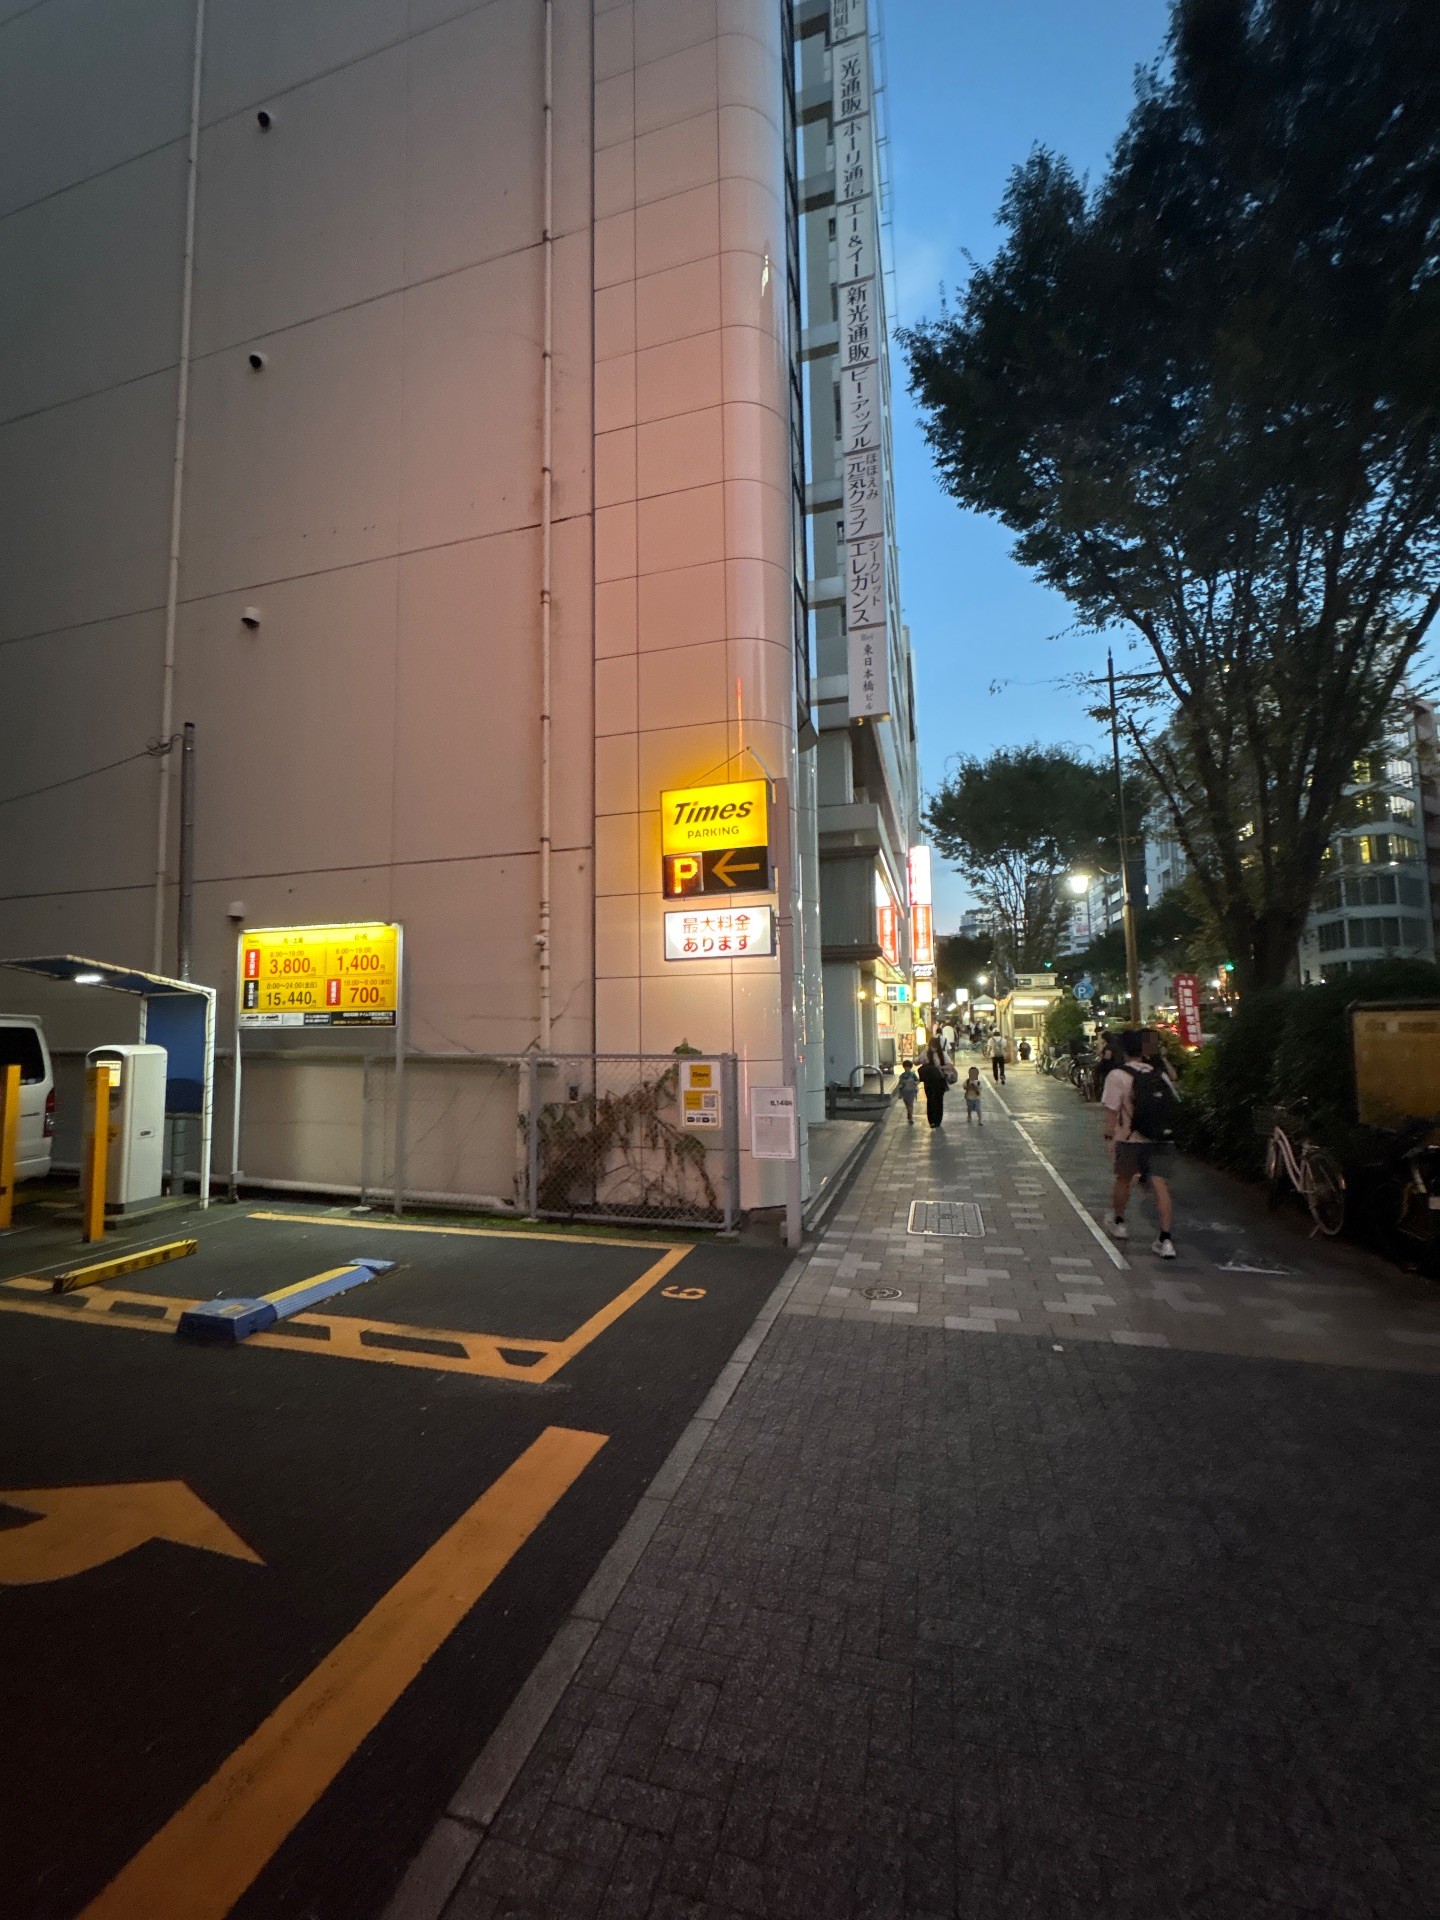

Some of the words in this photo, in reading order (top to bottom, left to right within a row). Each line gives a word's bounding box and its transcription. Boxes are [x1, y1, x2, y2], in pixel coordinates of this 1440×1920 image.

[847, 284, 872, 365] 新光通販
[846, 455, 868, 536] 元気クラブ
[865, 451, 880, 499] ほほえみ
[850, 541, 871, 625] エレガンス
[868, 540, 883, 606] シークレット
[862, 643, 875, 710] 東日本橋ビル
[673, 800, 754, 825] Times
[687, 825, 740, 839] PARKING
[673, 857, 699, 894] P
[683, 914, 751, 934] 最大料金
[683, 934, 751, 953] あります
